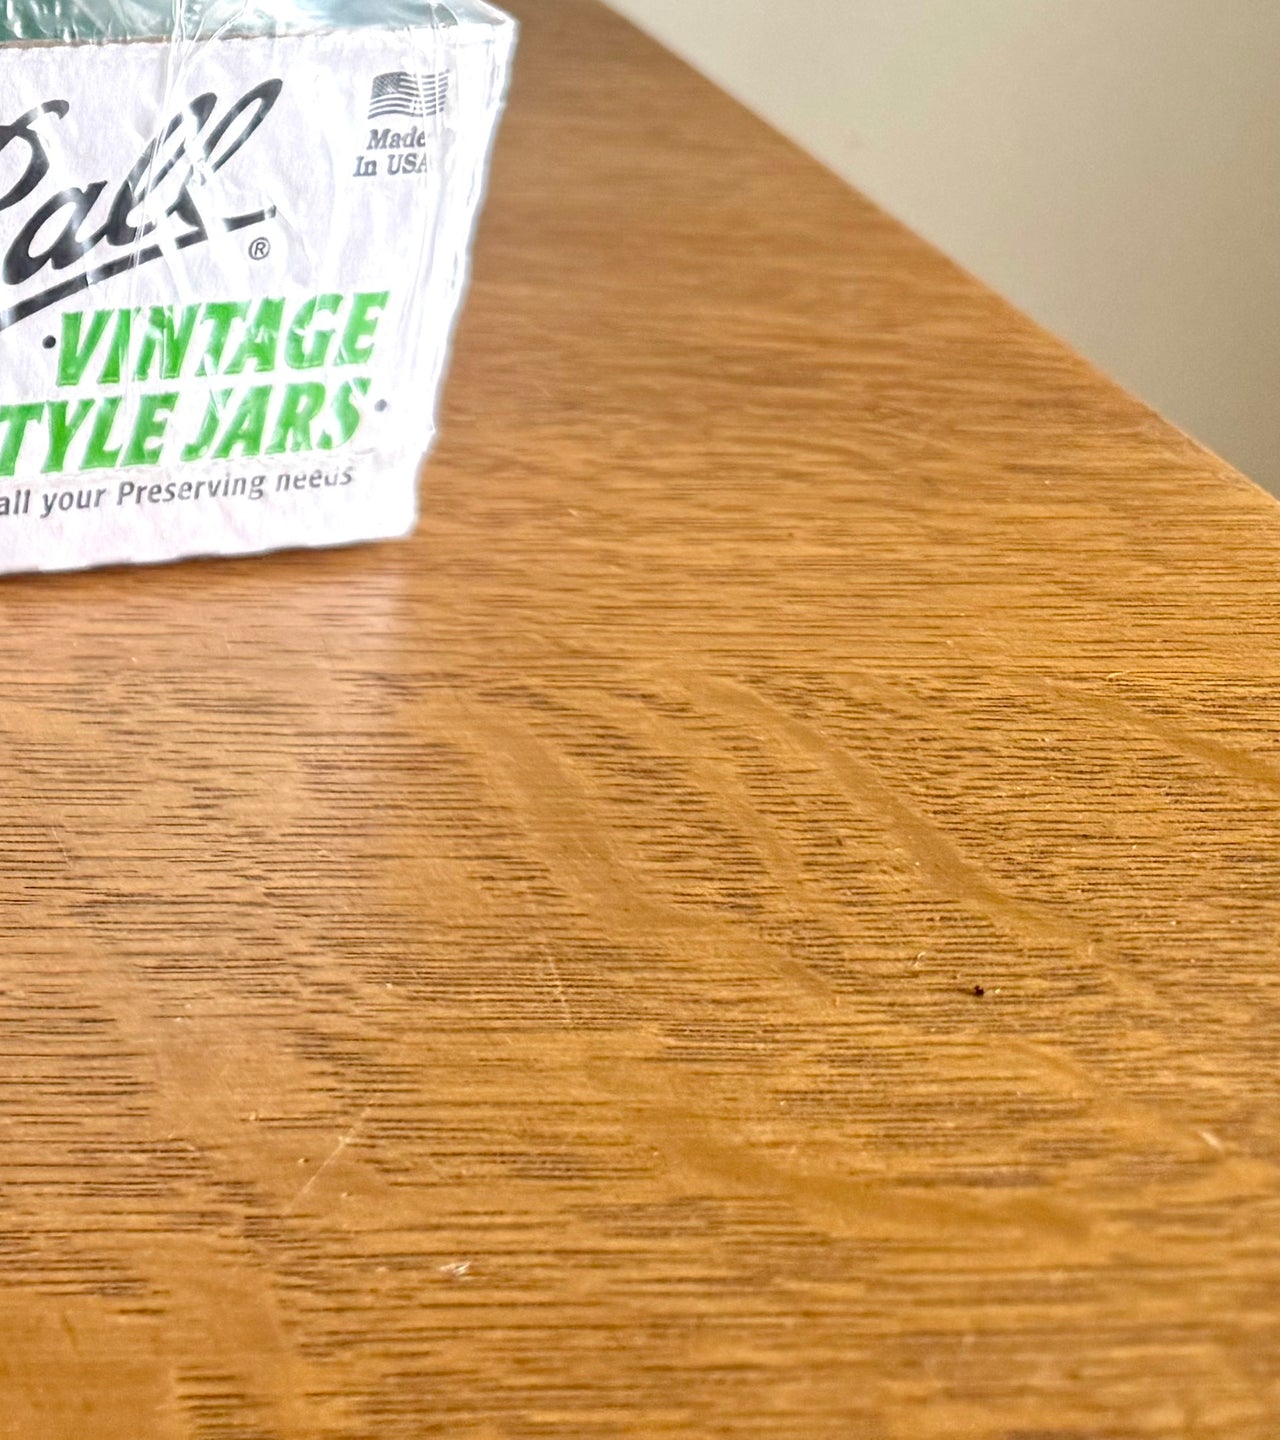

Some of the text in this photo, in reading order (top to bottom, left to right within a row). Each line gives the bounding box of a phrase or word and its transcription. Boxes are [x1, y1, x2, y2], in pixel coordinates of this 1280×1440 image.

[366, 125, 426, 150] Made
[352, 152, 428, 177] In USA
[55, 289, 390, 388] VINTAGE
[178, 376, 372, 463] JARS
[39, 487, 107, 519] your
[116, 471, 267, 507] Preserving
